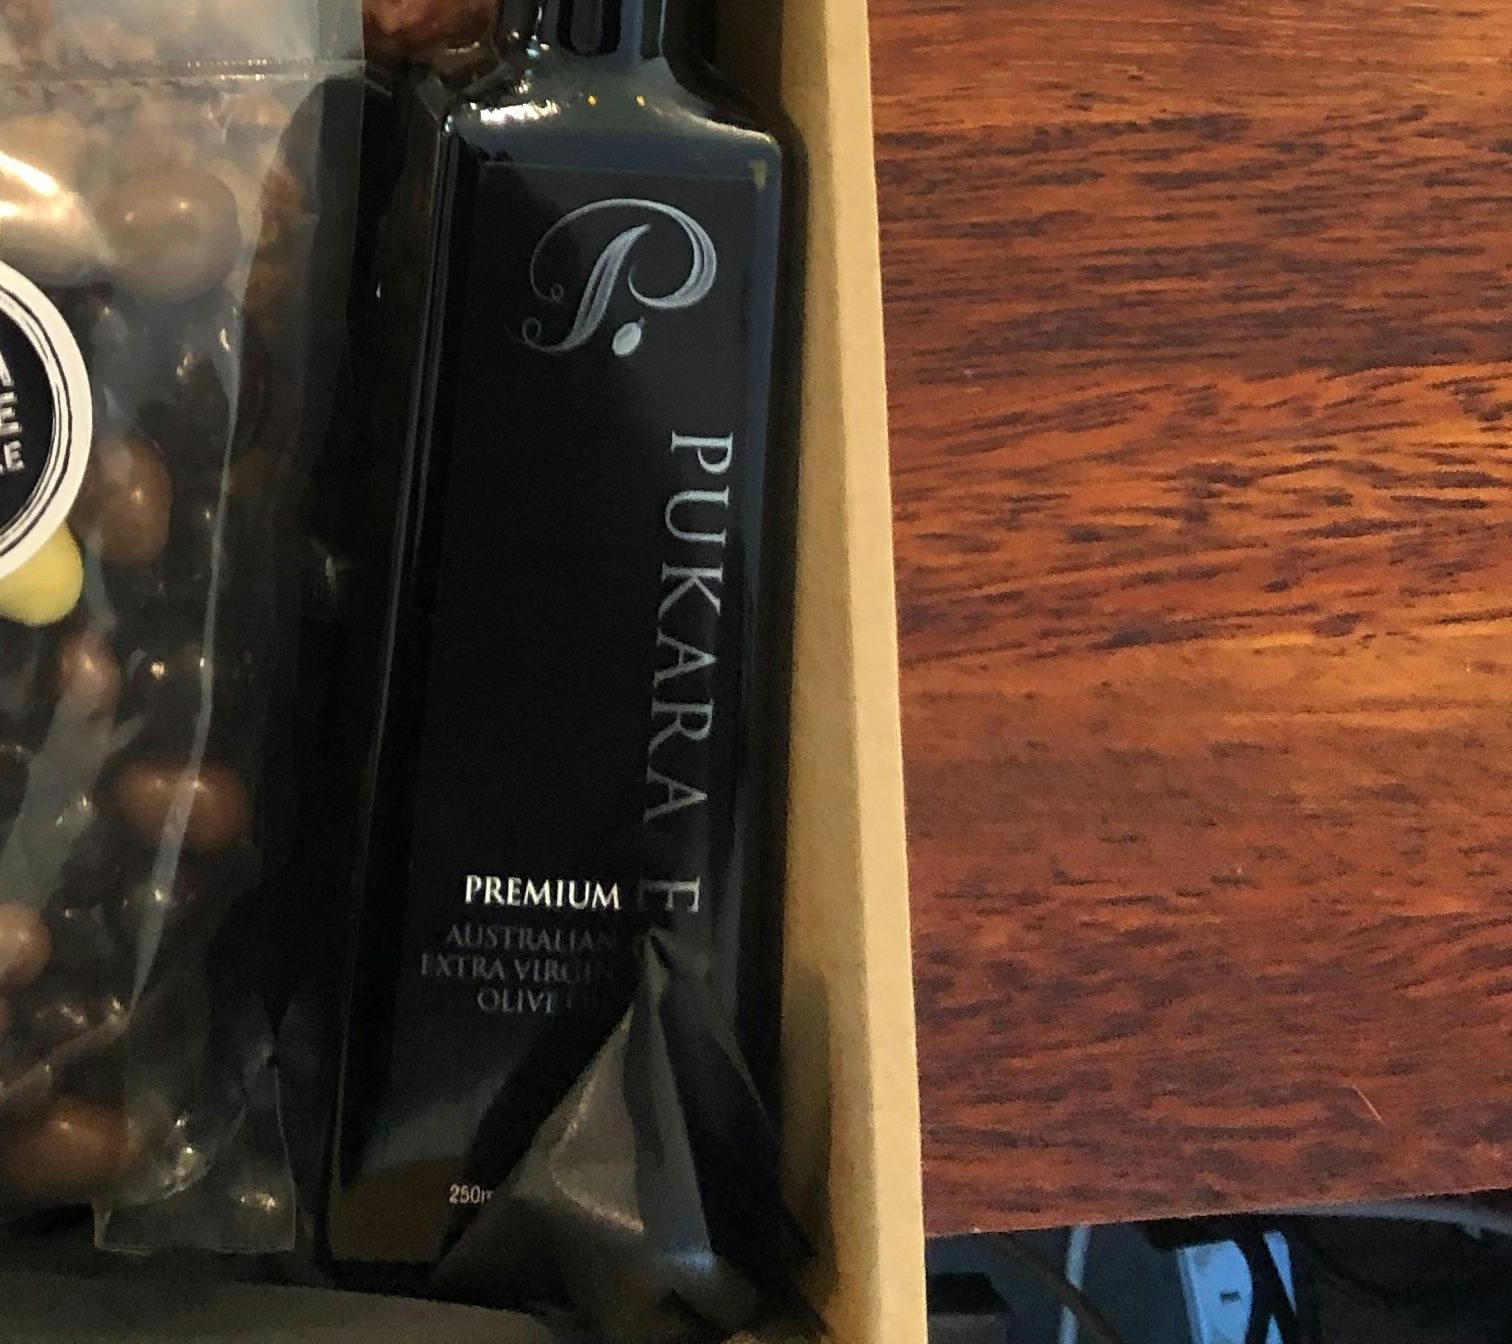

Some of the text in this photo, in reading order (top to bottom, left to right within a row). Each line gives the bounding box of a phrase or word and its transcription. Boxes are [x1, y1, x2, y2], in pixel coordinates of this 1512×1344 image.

[642, 429, 735, 827] PUKARA
[463, 874, 622, 912] PREMIUM
[420, 951, 506, 980] EXTRA
